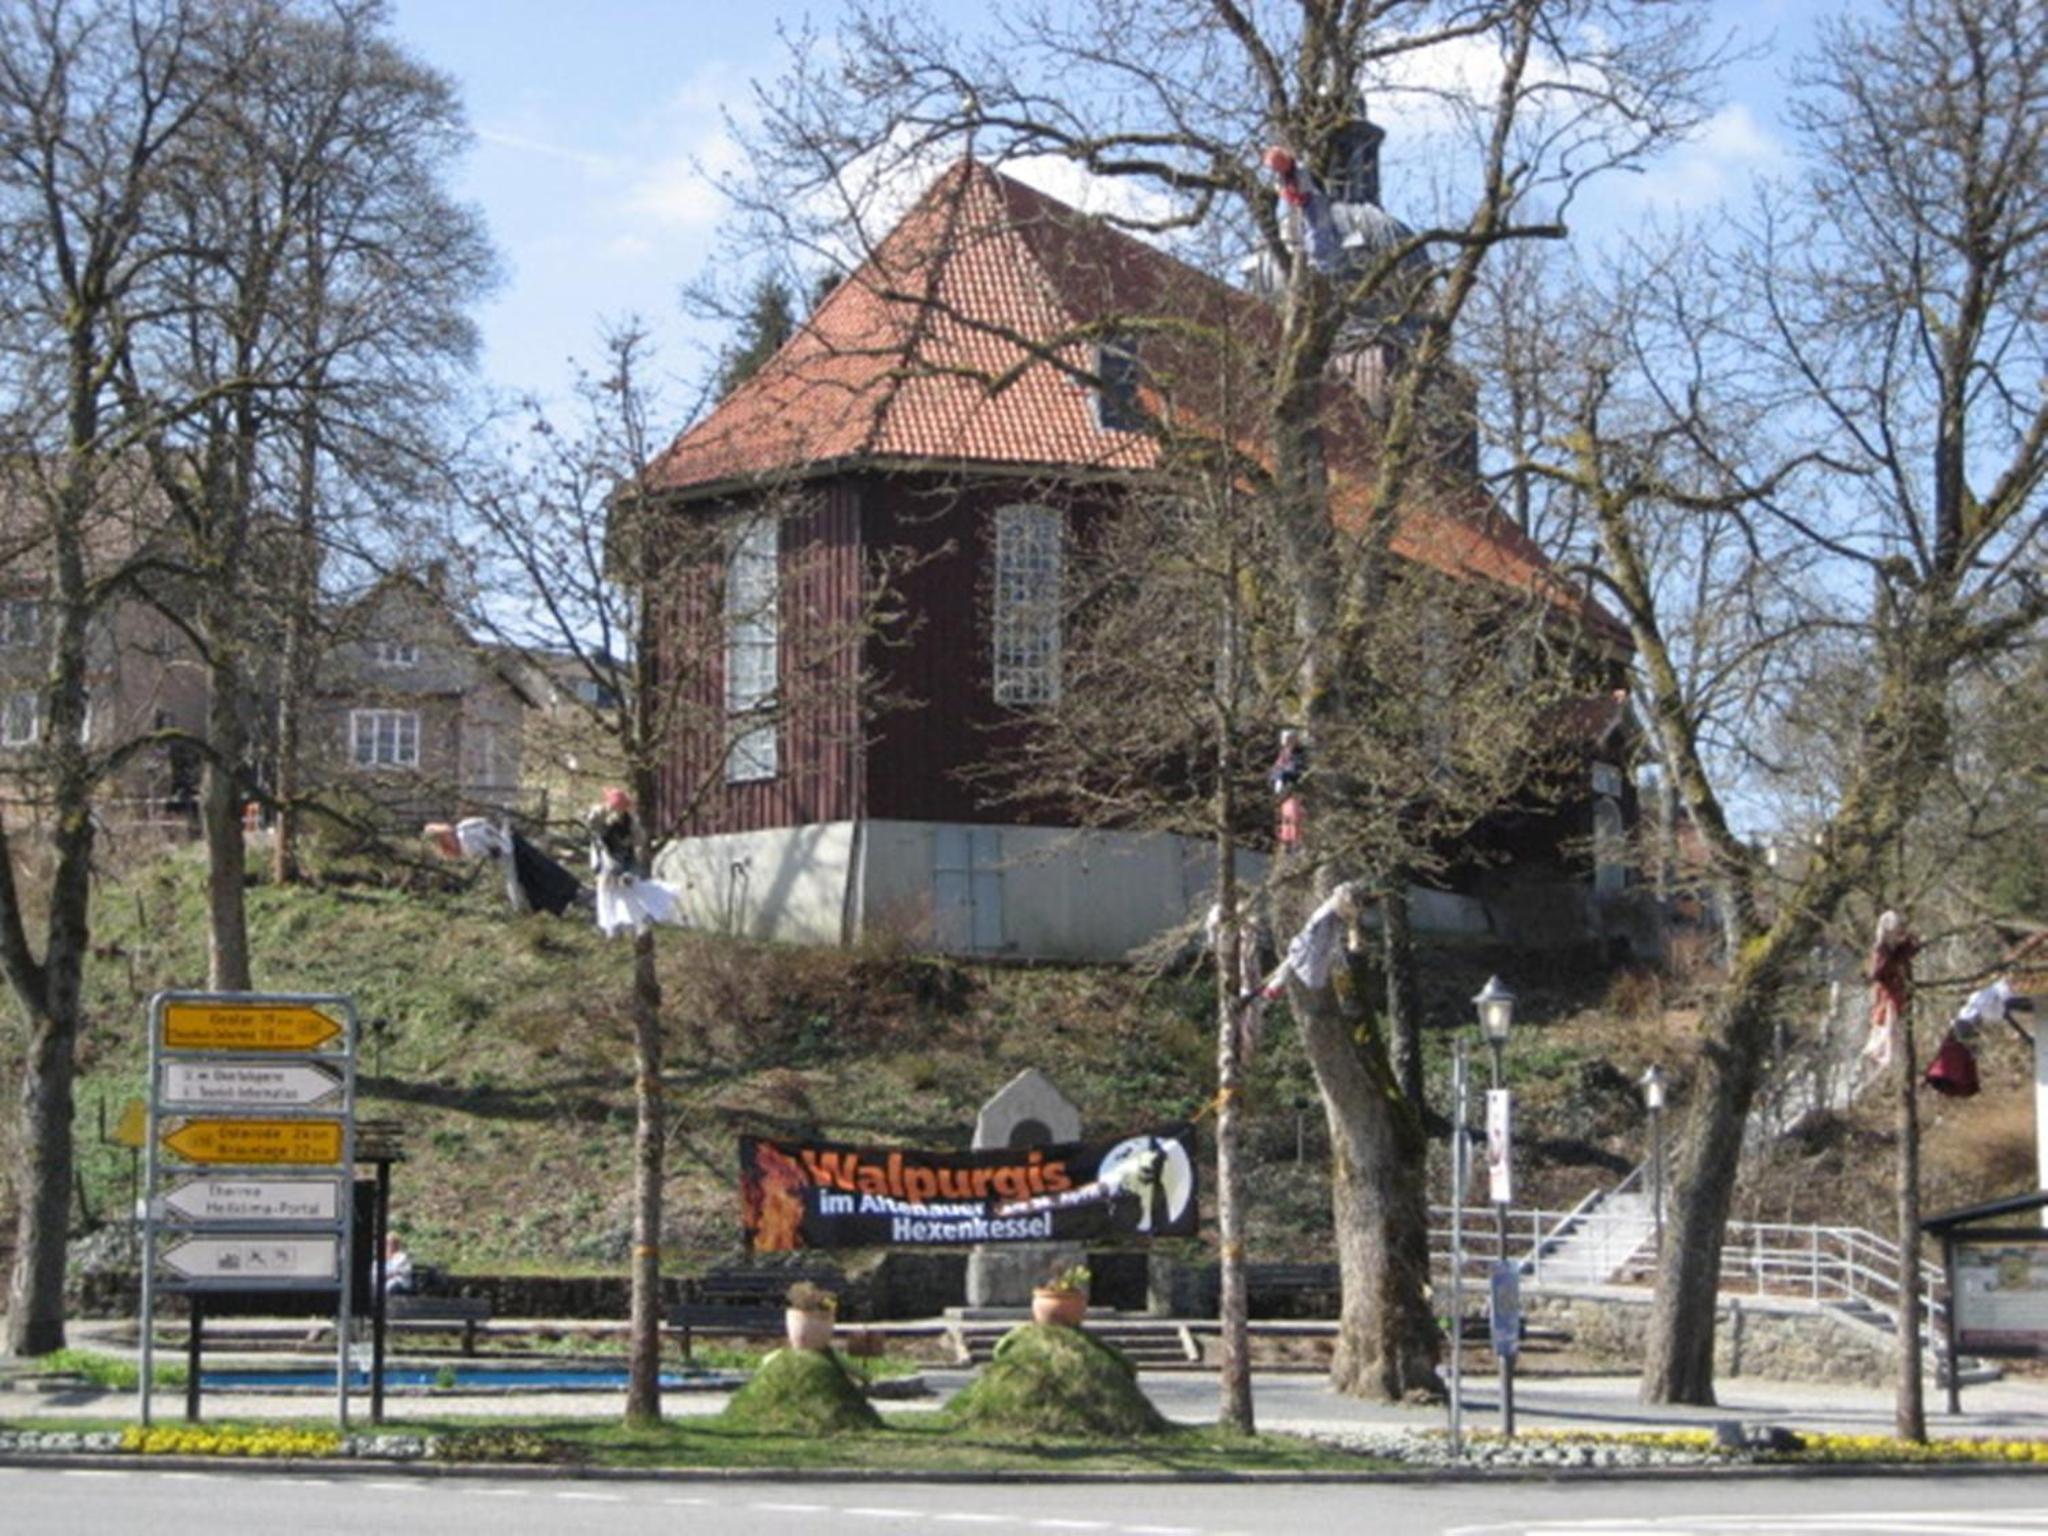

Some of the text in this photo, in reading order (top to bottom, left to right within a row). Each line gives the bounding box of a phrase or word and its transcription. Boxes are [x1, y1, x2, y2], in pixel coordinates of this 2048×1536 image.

[802, 1149, 1072, 1202] Walpurgis
[819, 1189, 854, 1215] im
[893, 1212, 1052, 1242] Hexenkessel
